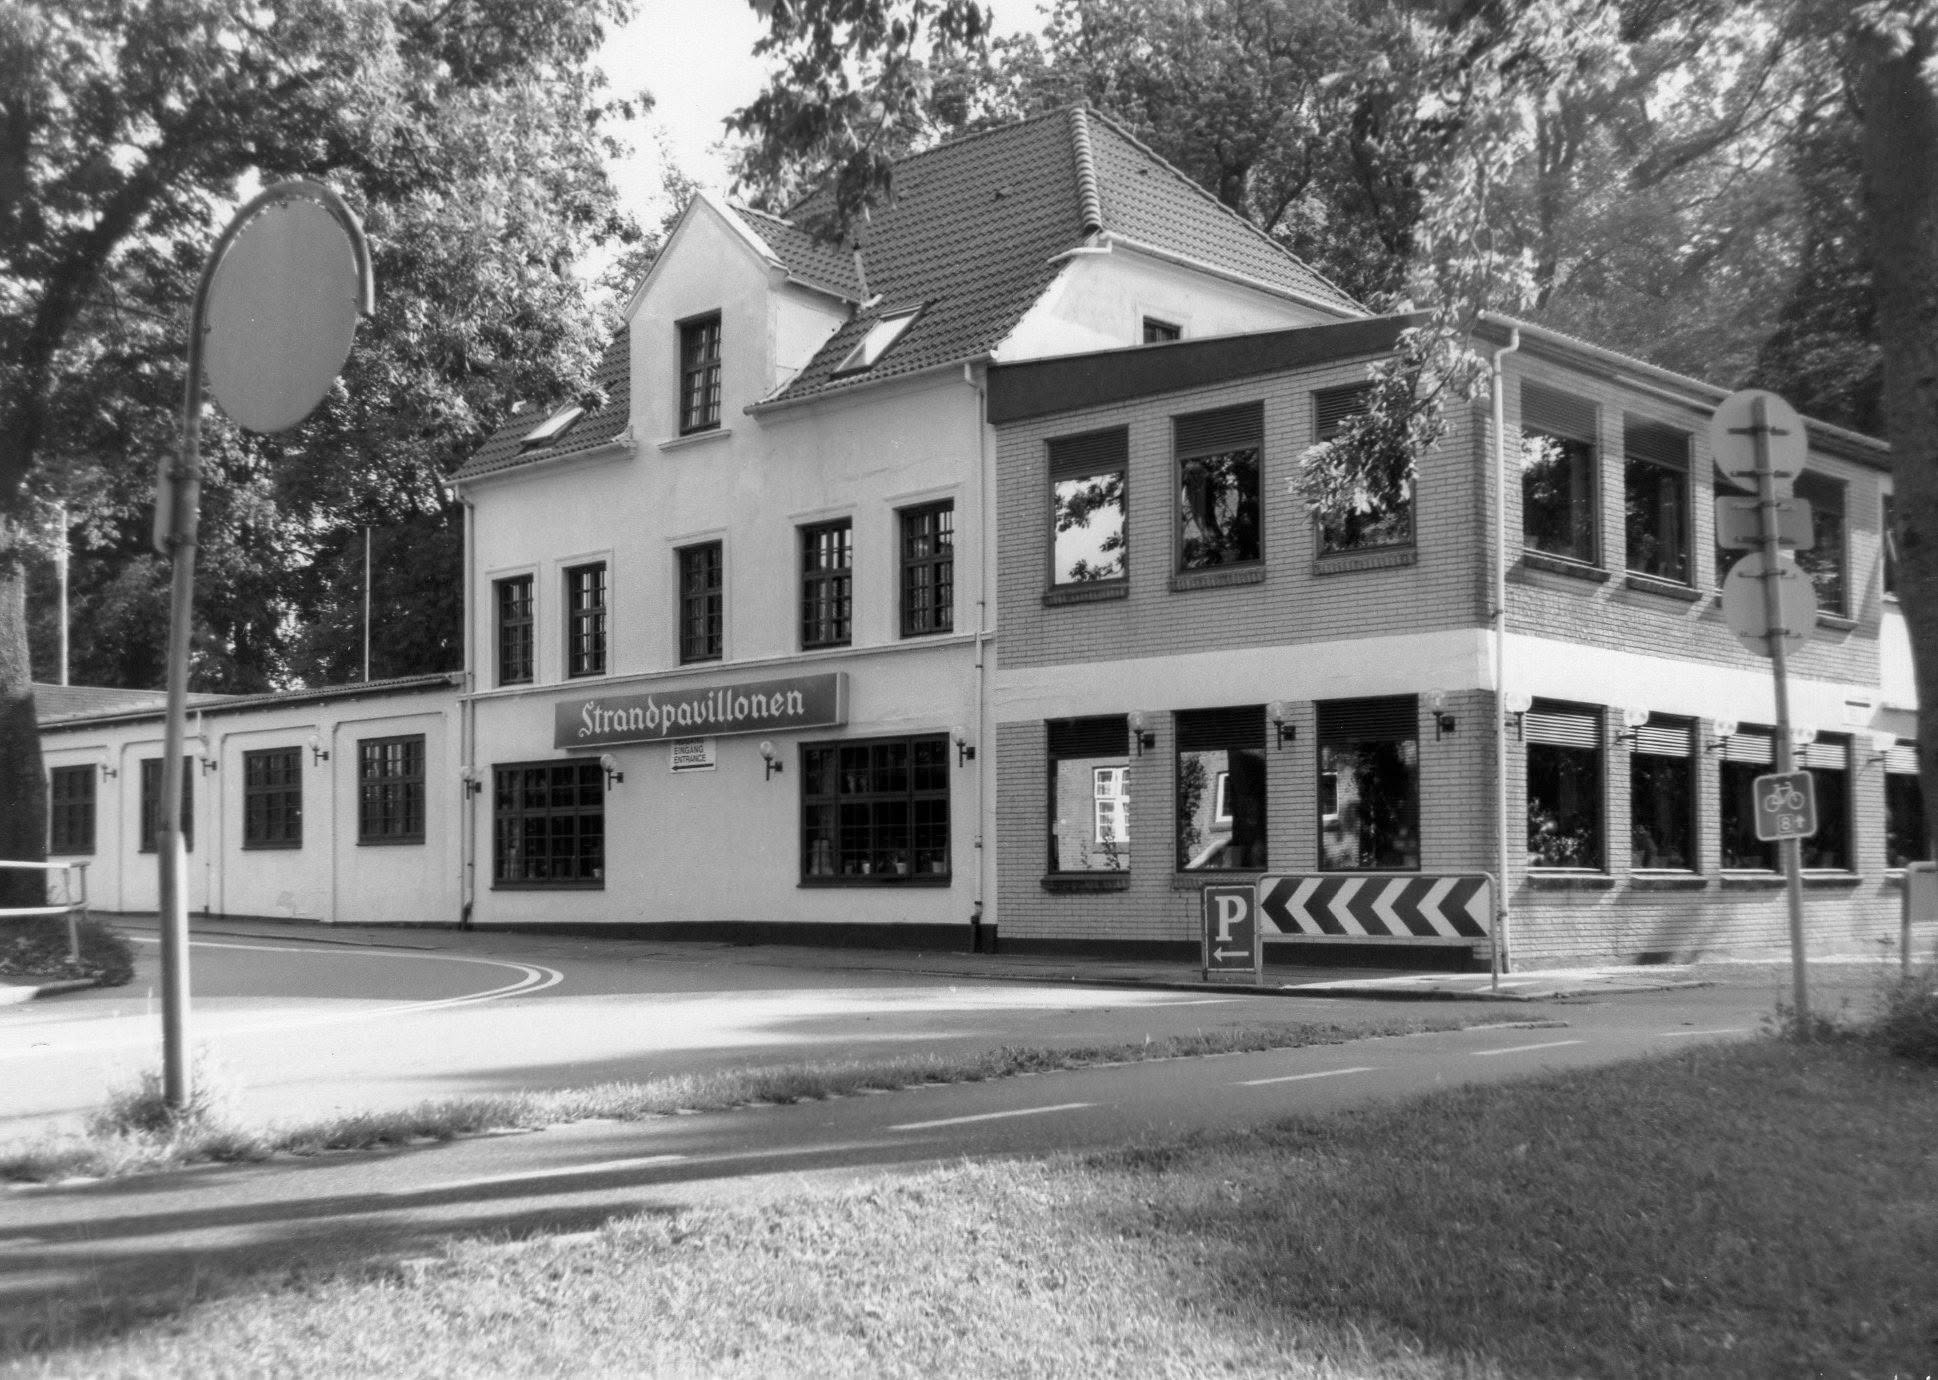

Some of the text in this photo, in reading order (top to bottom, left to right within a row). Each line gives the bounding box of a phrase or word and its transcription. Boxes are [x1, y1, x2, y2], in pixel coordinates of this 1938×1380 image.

[578, 689, 805, 738] Strandpavillonen
[673, 744, 704, 755] EINGANG
[673, 754, 707, 764] ENTRANCE
[1214, 895, 1248, 942] P
